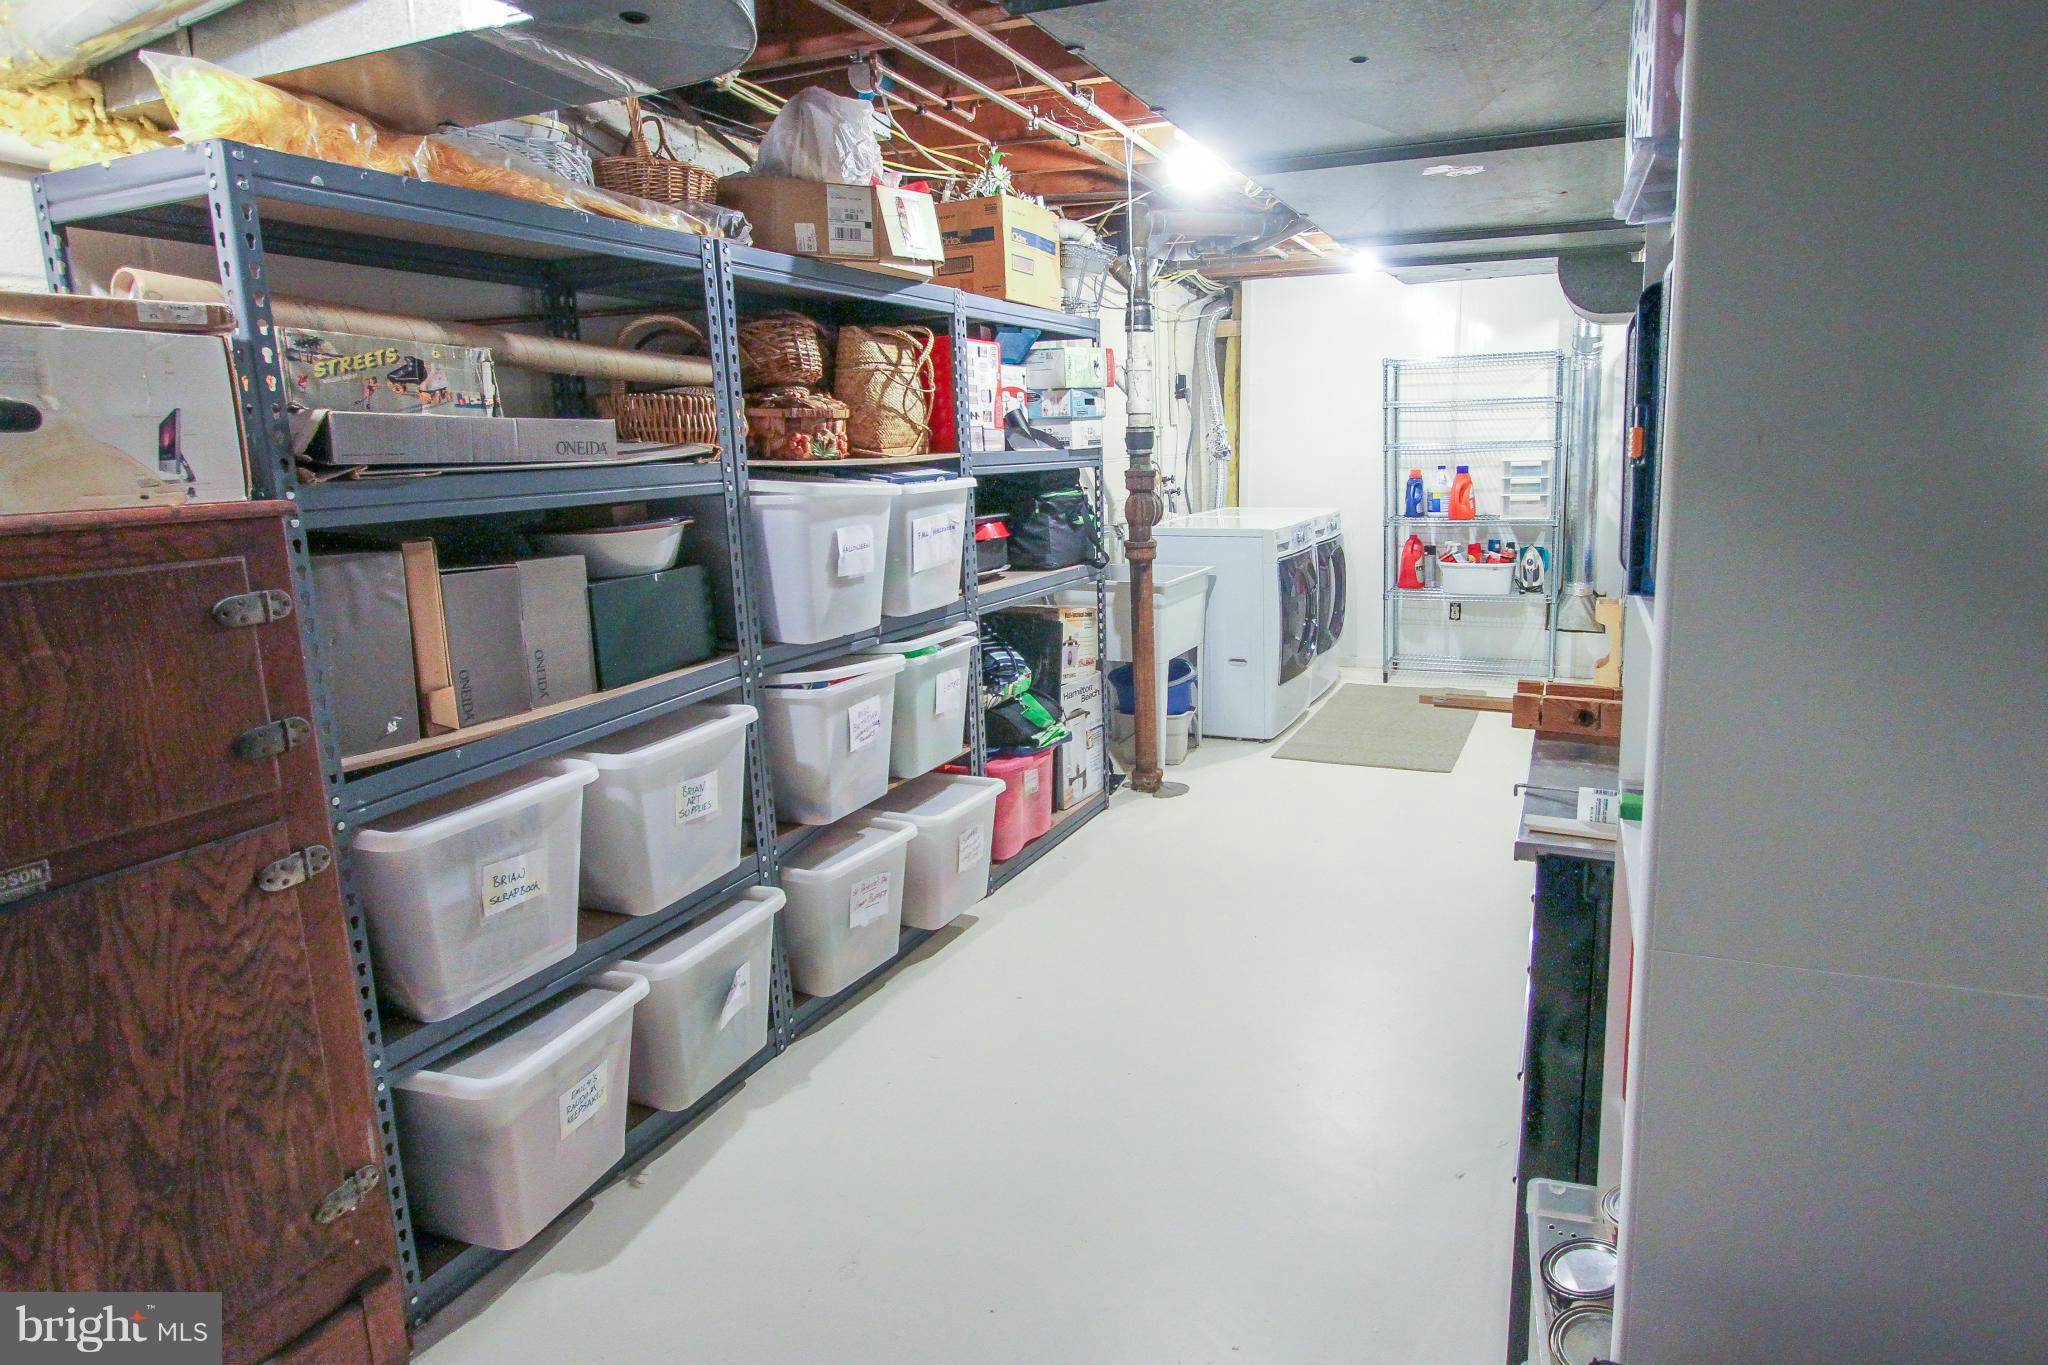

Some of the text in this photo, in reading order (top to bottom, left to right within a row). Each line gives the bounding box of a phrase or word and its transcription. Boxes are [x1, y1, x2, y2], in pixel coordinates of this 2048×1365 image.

[313, 347, 400, 378] STREETS
[556, 440, 608, 456] ONEIDA
[535, 649, 550, 699] ONEIDA
[459, 669, 475, 721] ONEIDA
[1063, 684, 1093, 701] Hamilton
[1080, 688, 1101, 703] Beach
[682, 780, 706, 797] BRIAN
[686, 794, 702, 806] ART
[679, 800, 712, 818] SUPPLIES
[492, 867, 526, 888] BRIAN
